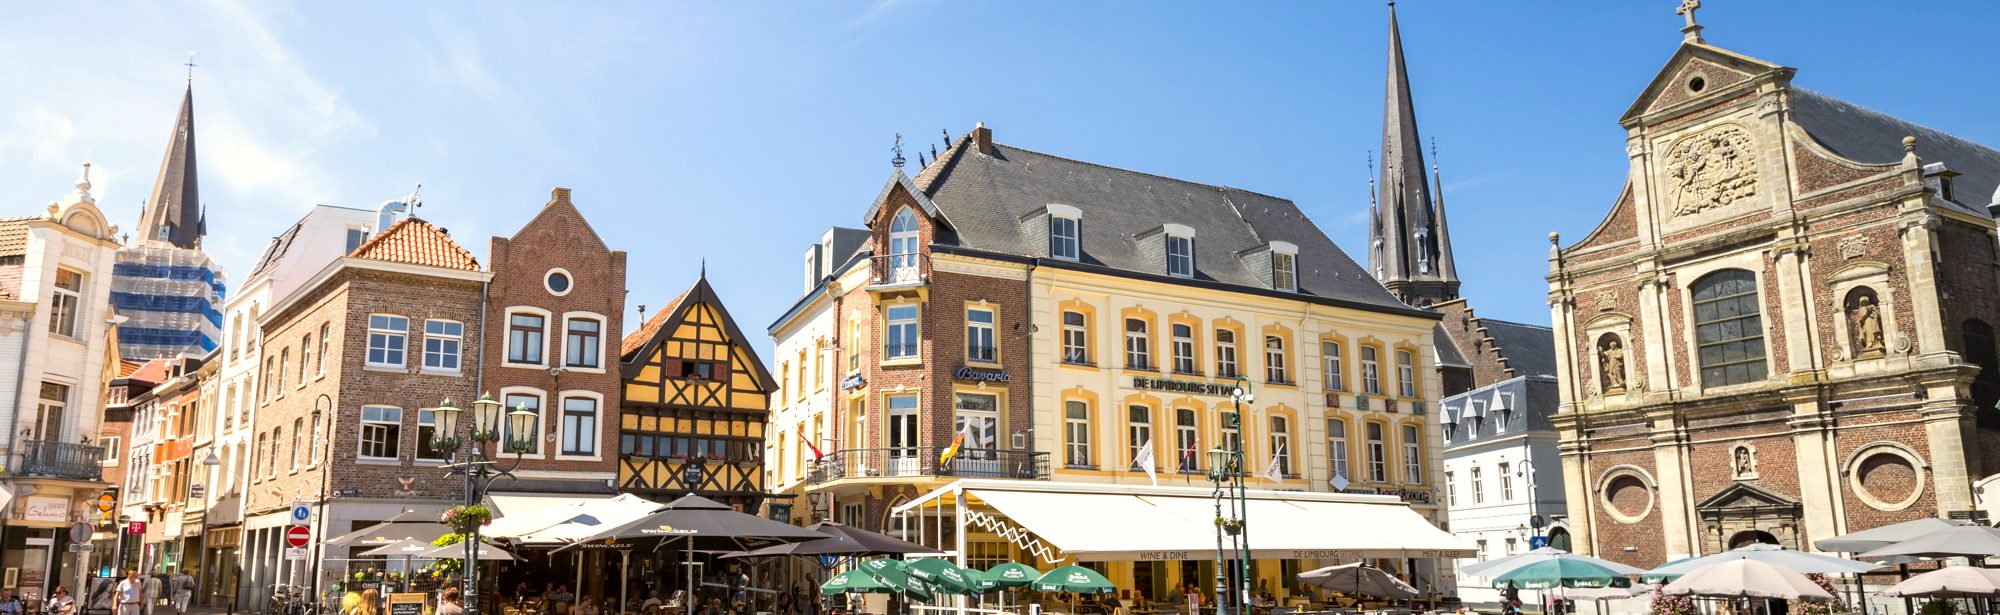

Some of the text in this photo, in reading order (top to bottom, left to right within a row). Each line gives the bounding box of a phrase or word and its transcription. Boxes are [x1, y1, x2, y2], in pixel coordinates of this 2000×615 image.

[956, 367, 1011, 382] Bavaria
[1134, 378, 1149, 389] DE
[1150, 379, 1206, 395] LIMBOURG
[1140, 551, 1189, 560] WINE & DINE
[1293, 550, 1303, 558] DE
[1304, 550, 1339, 558] LIMBOURG
[1444, 550, 1461, 558] SLEEP
